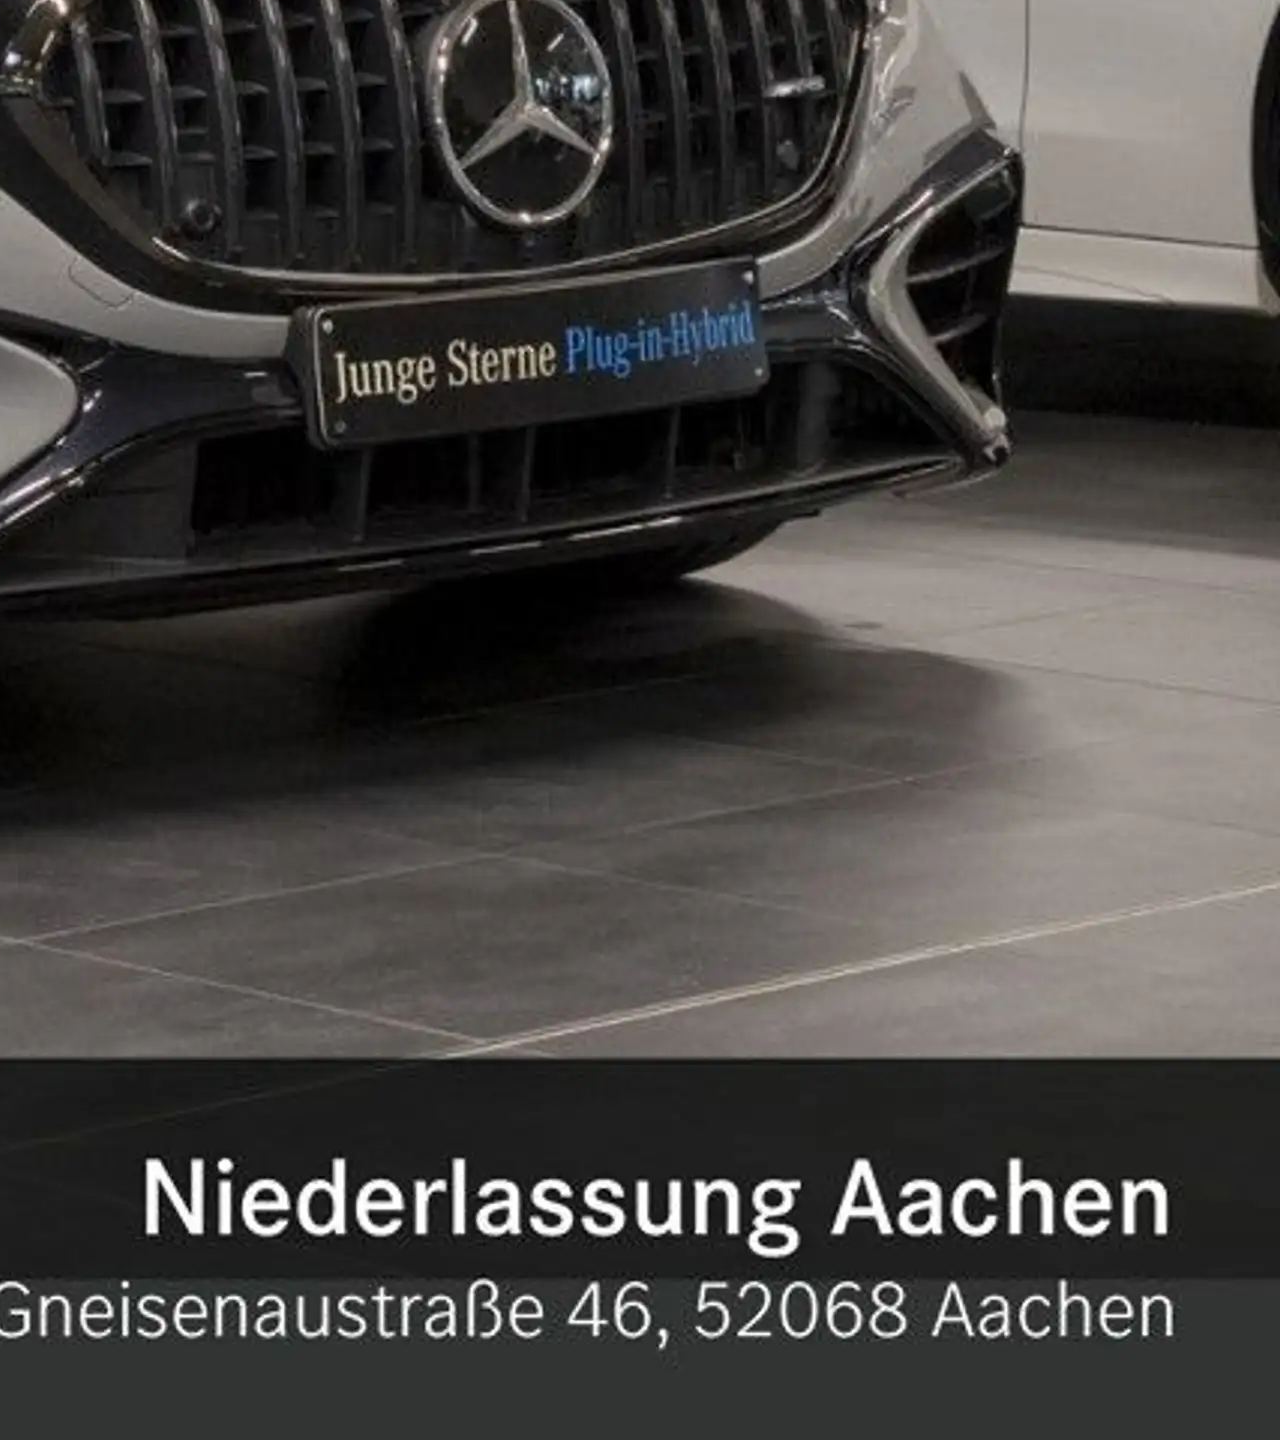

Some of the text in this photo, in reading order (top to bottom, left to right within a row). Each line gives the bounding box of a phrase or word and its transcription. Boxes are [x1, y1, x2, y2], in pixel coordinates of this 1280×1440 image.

[334, 302, 755, 405] Junge Sterne Plug-in-Hybrid
